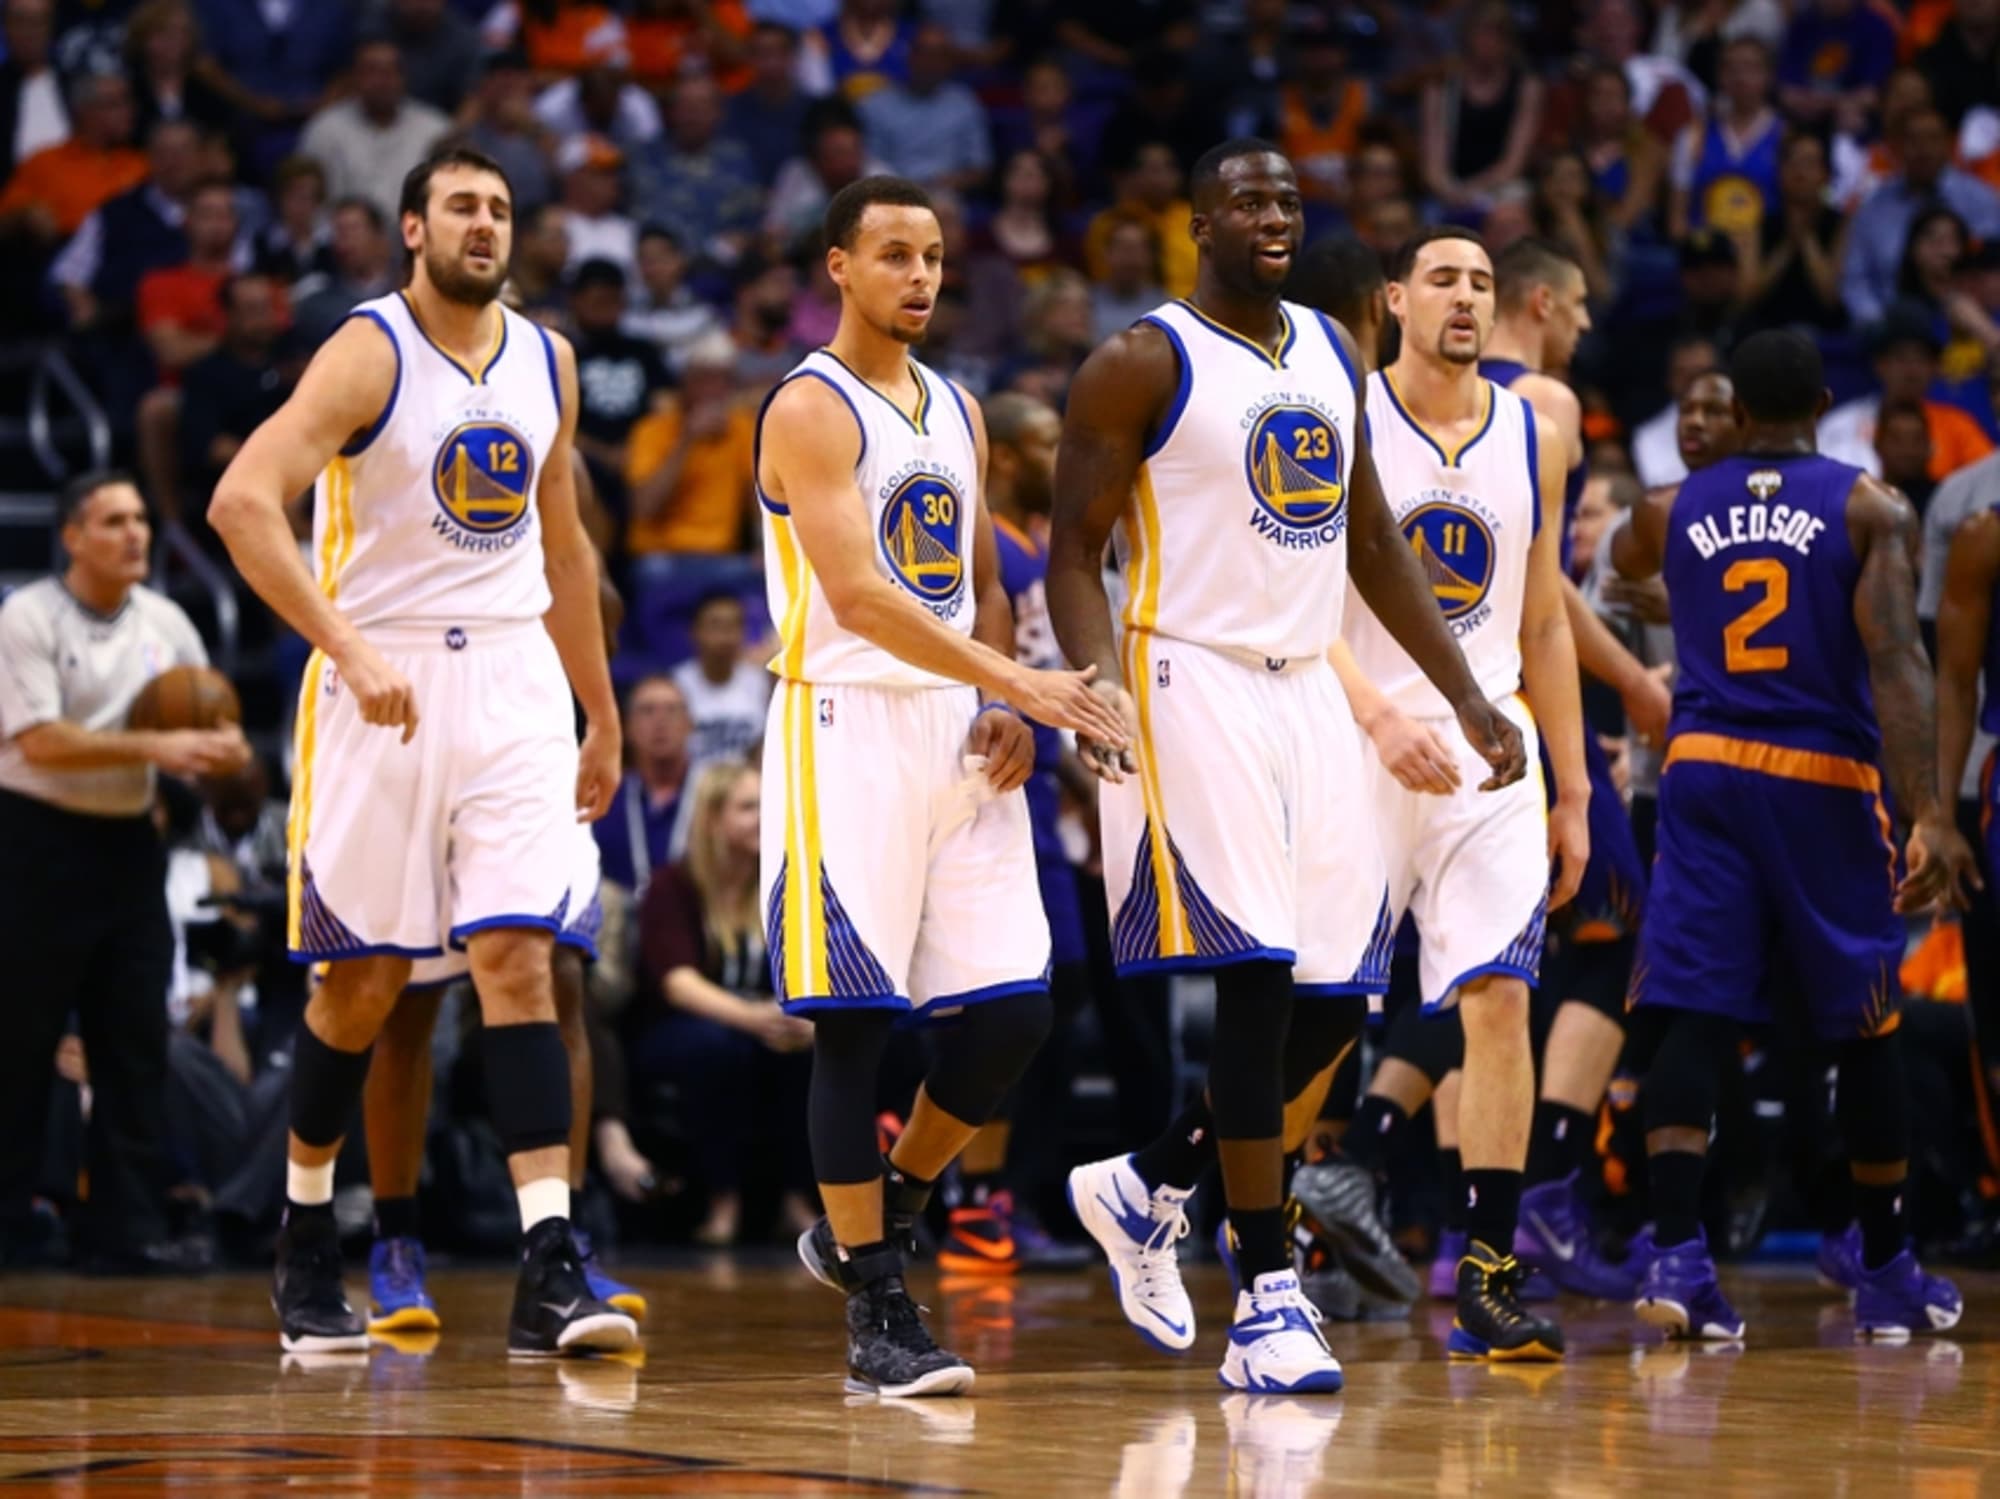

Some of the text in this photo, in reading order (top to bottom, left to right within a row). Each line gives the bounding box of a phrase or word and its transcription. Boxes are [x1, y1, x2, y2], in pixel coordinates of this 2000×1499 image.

[488, 441, 518, 472] 12
[1293, 427, 1331, 460] 23
[922, 493, 954, 526] 30
[1442, 523, 1467, 556] 11
[1687, 504, 1826, 561] BLEDSOE
[1723, 557, 1789, 674] 2
